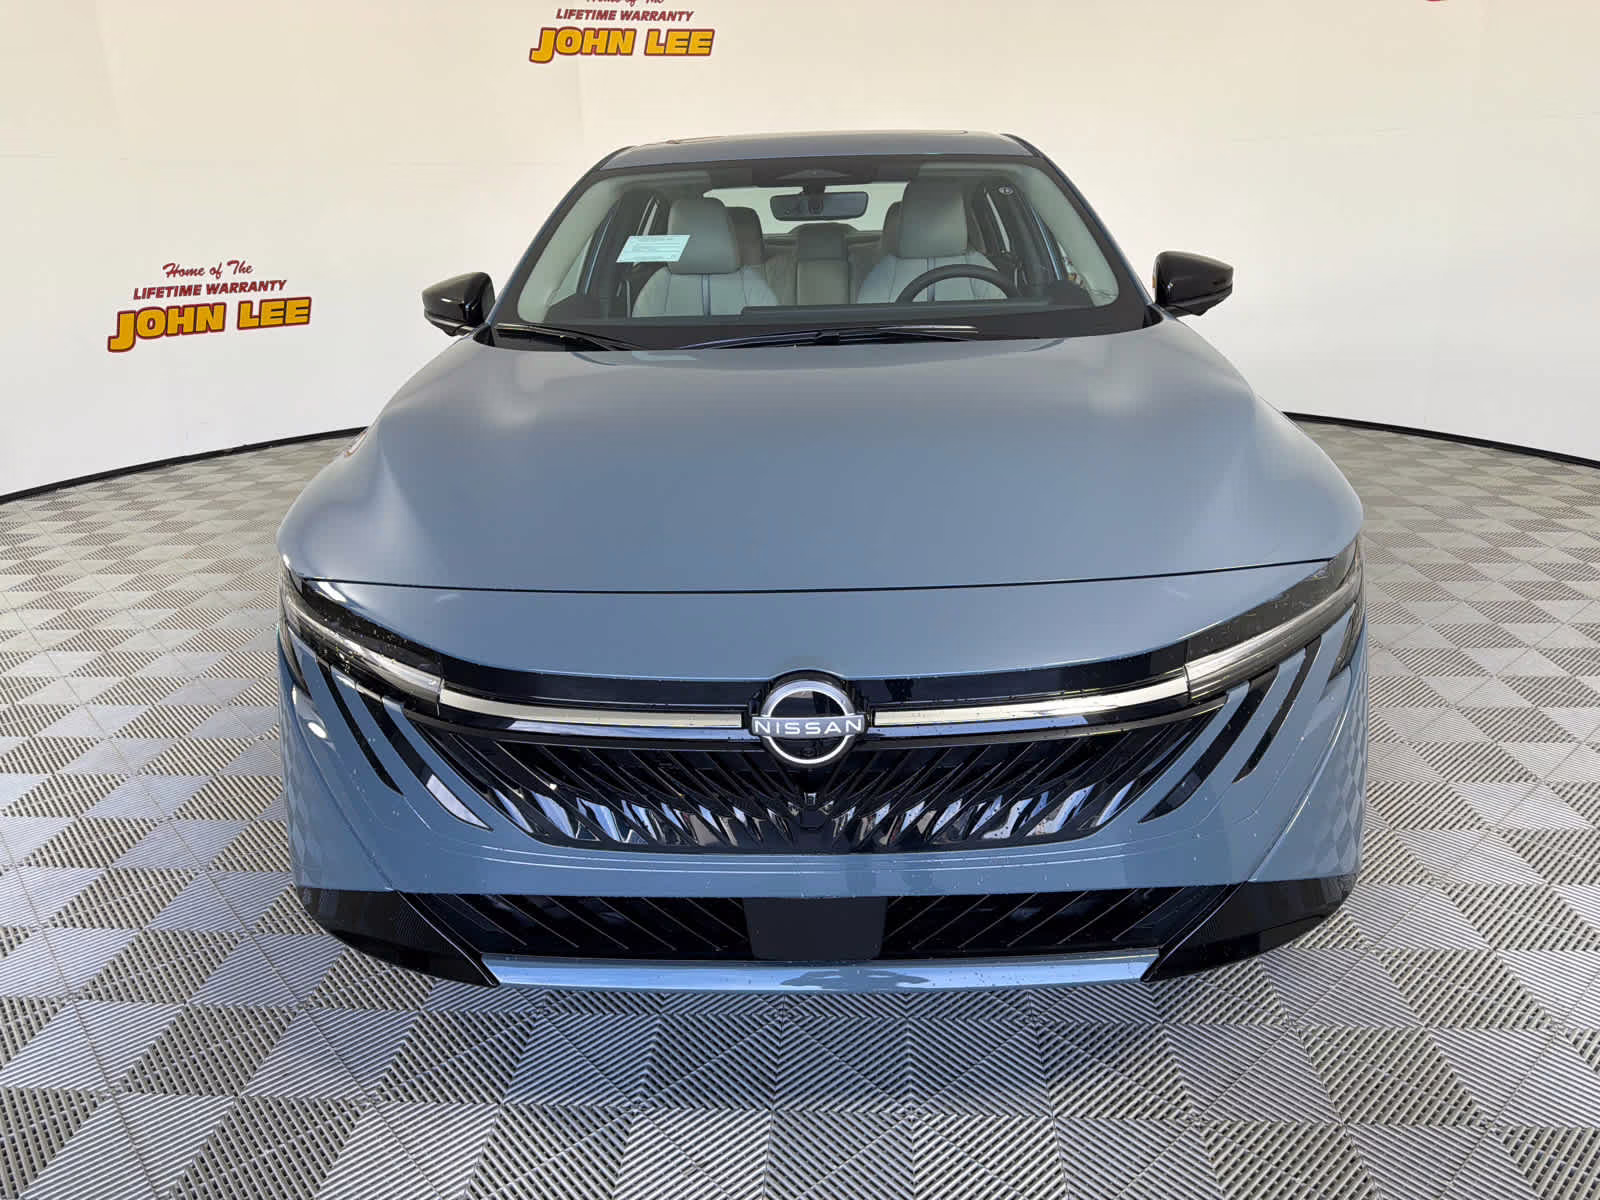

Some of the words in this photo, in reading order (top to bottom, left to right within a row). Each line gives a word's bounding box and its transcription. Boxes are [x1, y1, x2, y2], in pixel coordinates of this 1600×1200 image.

[556, 9, 616, 20] LIFETIME
[620, 11, 693, 21] WARRANTY
[529, 26, 636, 63] JOHN
[644, 29, 715, 56] LEE
[163, 263, 205, 277] Home
[209, 262, 223, 279] of
[227, 260, 253, 275] The
[133, 284, 202, 300] LIFETIME
[206, 279, 286, 296] WARRANTY
[108, 302, 226, 352] JOHN
[237, 297, 311, 329] LEE
[754, 719, 861, 735] NISSAN
